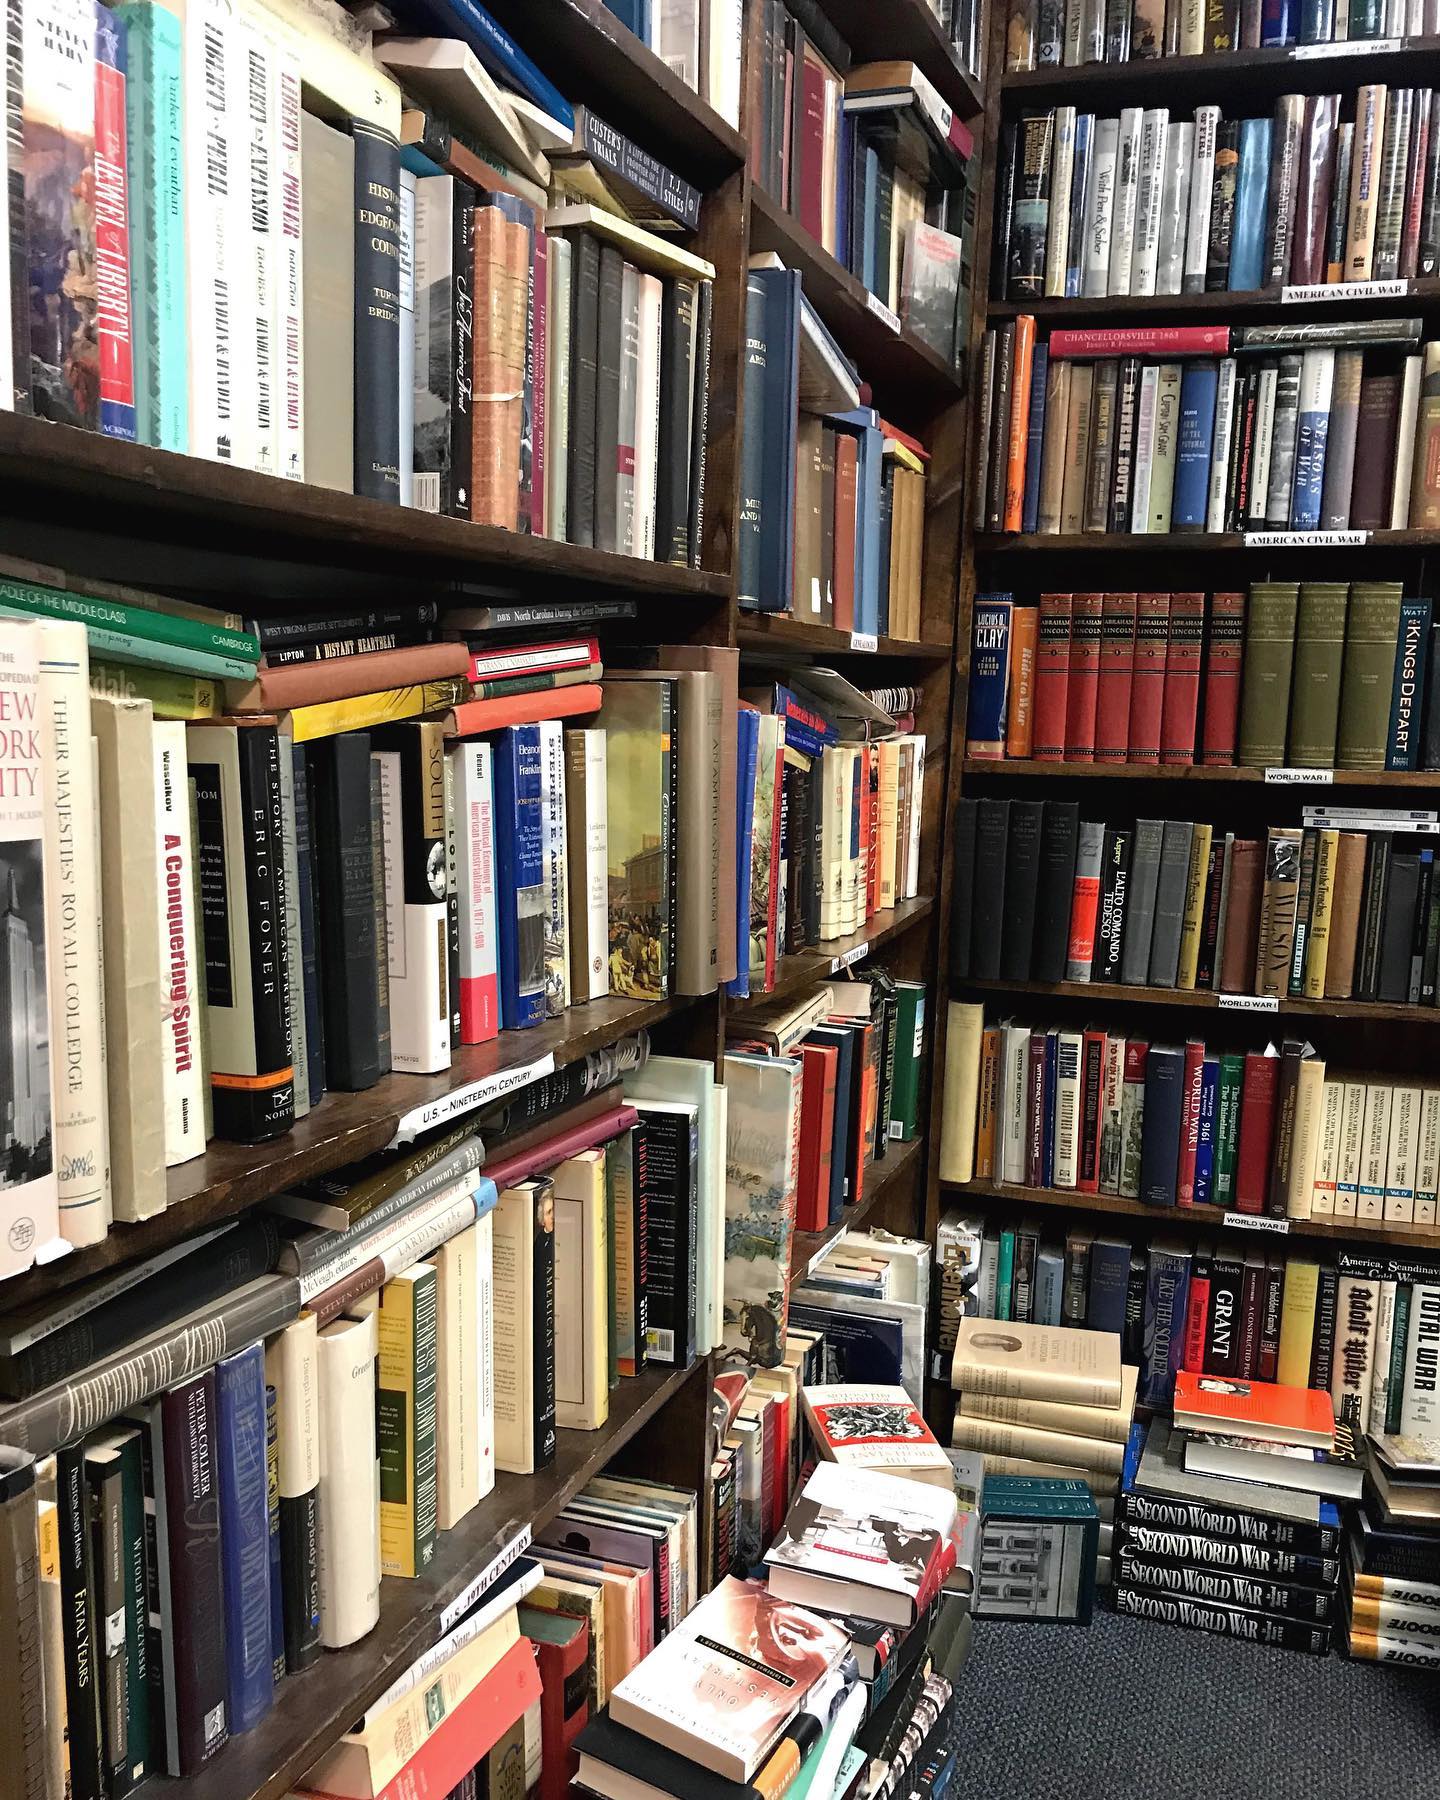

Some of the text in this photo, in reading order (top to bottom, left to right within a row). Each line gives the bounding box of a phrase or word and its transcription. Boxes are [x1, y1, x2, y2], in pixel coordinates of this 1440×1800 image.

[205, 22, 225, 112] LIBERTY
[170, 75, 179, 132] Yankee
[589, 116, 622, 151] CUSTER'S
[592, 138, 618, 167] TRIALS
[95, 152, 124, 231] JEWEL
[663, 190, 684, 213] STILES
[1093, 164, 1113, 255] With Pen & Saber
[1273, 141, 1294, 261] CONFEDERATE GOLIATH
[96, 246, 129, 344] LIBERTY
[1287, 285, 1402, 300] AMERICAN CIVIL WAR
[1064, 331, 1157, 342] CHANCELLORSVILLE
[1115, 457, 1131, 503] SOUTH
[1297, 426, 1312, 486] OF WAR
[1311, 417, 1327, 494] SEASONS
[1251, 535, 1361, 545] AMERICAN CIVIL WAR
[211, 634, 254, 653] CAMBRIDGE
[976, 628, 1004, 648] CLAY
[978, 613, 998, 625] LUCIUS
[279, 649, 305, 662] LIPTON
[316, 634, 398, 660] A DISTANT HEARTBEAT
[1395, 626, 1421, 752] KINGS DEPART
[476, 753, 484, 779] Bensel
[518, 744, 541, 755] Eleanor
[519, 764, 541, 776] Franklin
[162, 750, 173, 812] Waselkov
[427, 747, 443, 834] SOUTH
[549, 738, 561, 932] STEPHEN E. AMBROSE
[1113, 837, 1125, 865] Asprey
[53, 697, 84, 1095] THEIR MAJESTIES' ROYALL COLLEDGE
[254, 808, 275, 997] ERIC FONER
[268, 736, 294, 1058] THE STORY AMERICAN FREEDOM
[1101, 892, 1115, 939] TEDESCO
[1108, 871, 1127, 962] L'ALTO COMANDO
[163, 833, 195, 1076] A Conquering Spirit
[1270, 893, 1295, 971] WILSON
[1060, 1042, 1078, 1079] BLOWBACK
[182, 1097, 190, 1135] Alabama
[422, 1069, 532, 1123] U.S. NINETEENTH CENTURY
[1219, 1101, 1229, 1140] Rhineland
[1231, 1100, 1239, 1142] Occupation
[1060, 1133, 1072, 1159] SIMPSON
[1201, 1122, 1211, 1141] 1916
[639, 1137, 647, 1188] FURIOUS
[939, 1233, 957, 1241] CARLO
[1227, 1217, 1258, 1227] WORLD
[1259, 1221, 1280, 1230] WAR
[303, 1256, 358, 1295] McVeigh, editors
[1324, 1274, 1336, 1295] THE
[1340, 1254, 1384, 1269] America,
[319, 1274, 382, 1320] STEVEN STOLL
[938, 1244, 972, 1351] Eisenhower
[1319, 1297, 1334, 1335] HITLER
[1152, 1276, 1175, 1376] IKE THE SOLDIER
[1212, 1289, 1234, 1359] GRANT
[1319, 1340, 1330, 1351] OF
[1342, 1285, 1374, 1391] Adolf Hitler
[1414, 1290, 1440, 1393] TOTAL WAR
[58, 1316, 227, 1442] SEARCHING THE HEART
[416, 1277, 438, 1540] WILDERNESS AT DAWN TED MORGAN
[195, 1387, 214, 1496] PETER COLLIER
[71, 1466, 82, 1569] PRESTON AND HAINES
[1126, 1496, 1269, 1542] THE SECOND WORLD WAR
[306, 1497, 320, 1621] Anybody's Gold
[1138, 1526, 1271, 1573] SECOND WORLD WAR
[445, 1608, 461, 1629] U.S.
[488, 1534, 532, 1584] CENTURY
[1121, 1556, 1264, 1607] THE SECOND WORLD WAR
[132, 1536, 146, 1681] WITOLD RYBCZYNSKI
[1117, 1588, 1259, 1642] THE SECOND WORLD WAR
[74, 1587, 91, 1689] FATAL YEARS
[680, 1651, 781, 1707] YESTERDAY
[691, 1677, 740, 1707] ONLY
